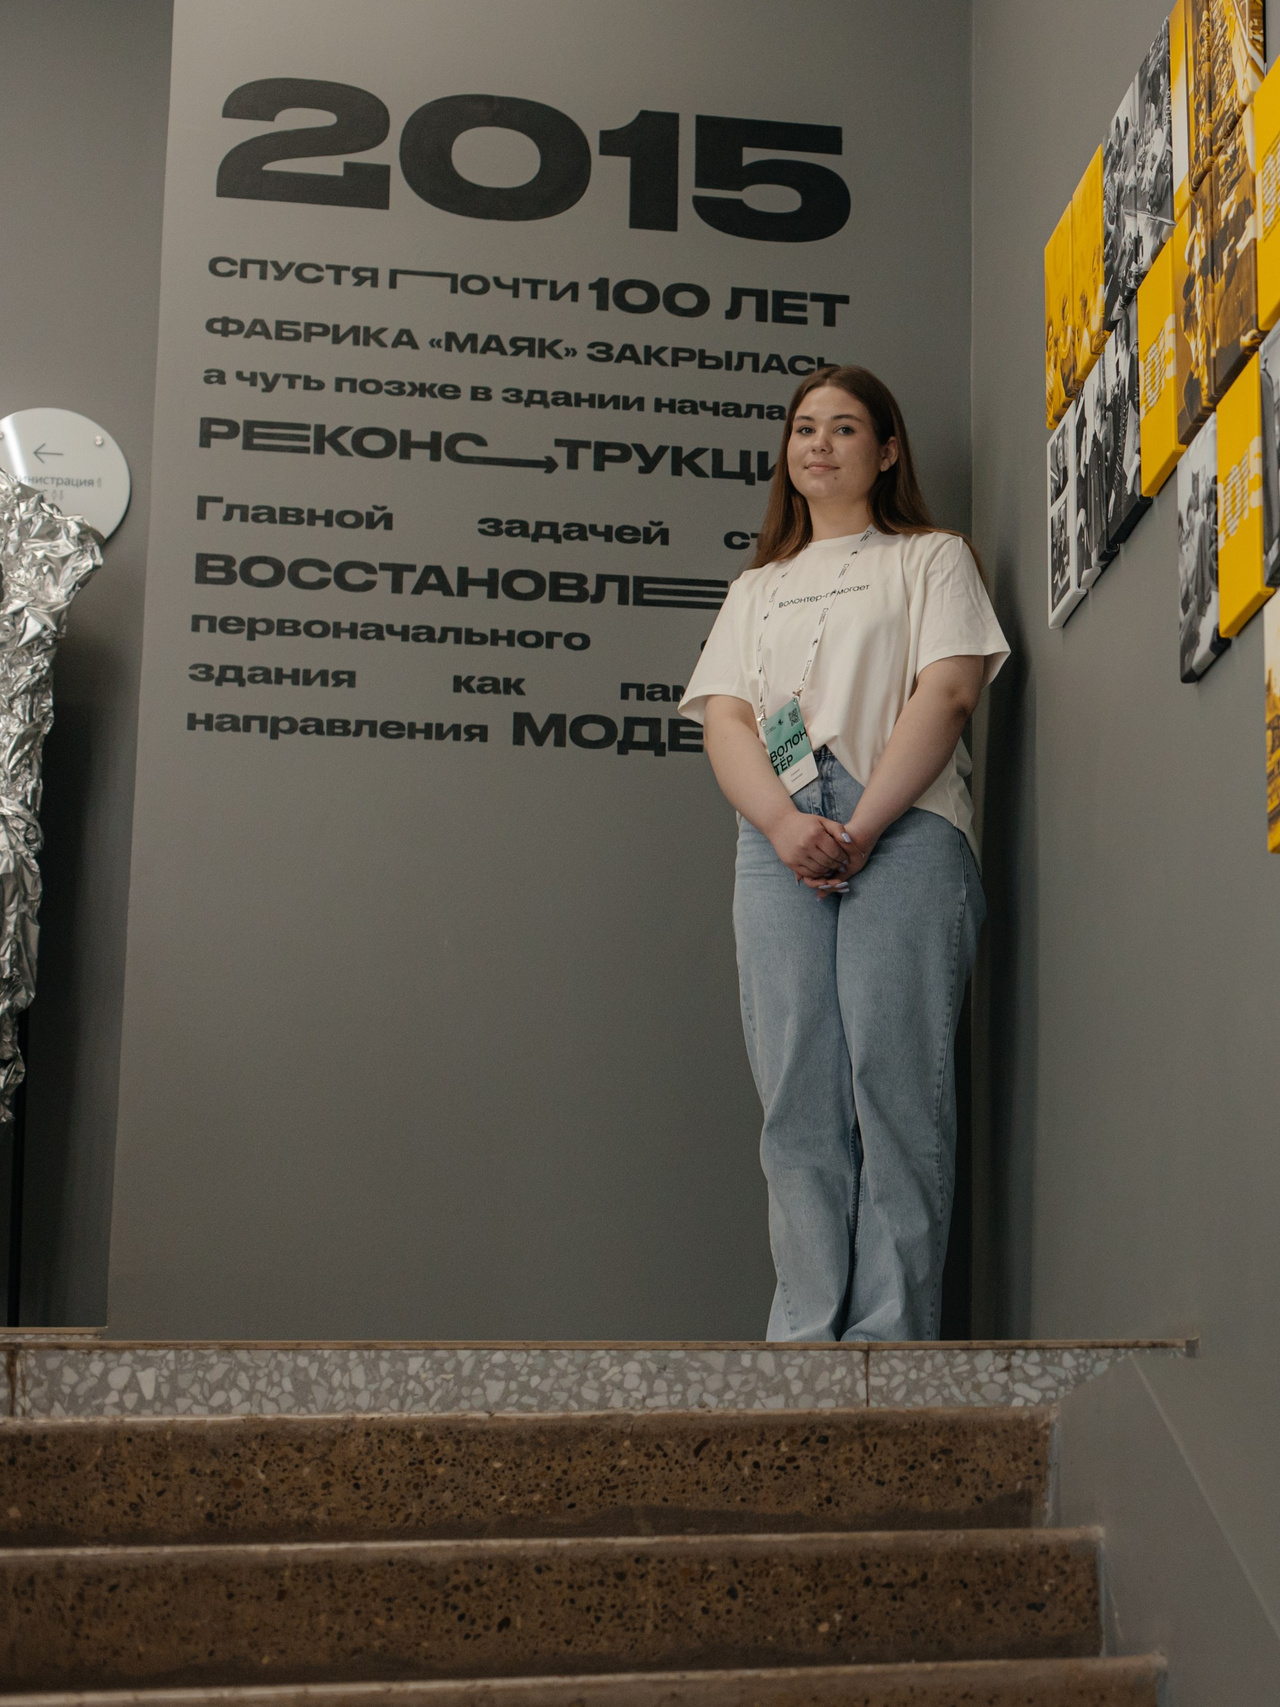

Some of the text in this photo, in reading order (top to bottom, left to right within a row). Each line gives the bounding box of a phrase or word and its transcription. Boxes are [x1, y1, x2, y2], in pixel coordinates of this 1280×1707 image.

[216, 78, 851, 243] 2015
[209, 257, 378, 288] СПУСТЯ
[588, 278, 711, 319] 100
[725, 287, 850, 327] ЛЕТ
[206, 317, 419, 350] ФАБРИКА
[429, 331, 577, 360] «МАЯК»
[204, 369, 226, 385] а
[236, 371, 325, 392] чуть
[335, 377, 461, 400] позже
[470, 386, 492, 401] в
[502, 388, 644, 412] здании
[197, 495, 393, 530] Главной
[478, 518, 669, 546] задачей
[191, 615, 590, 651] первоначального
[189, 664, 356, 688] здания
[453, 675, 526, 696] как
[187, 712, 704, 757] направления МОДЕ
